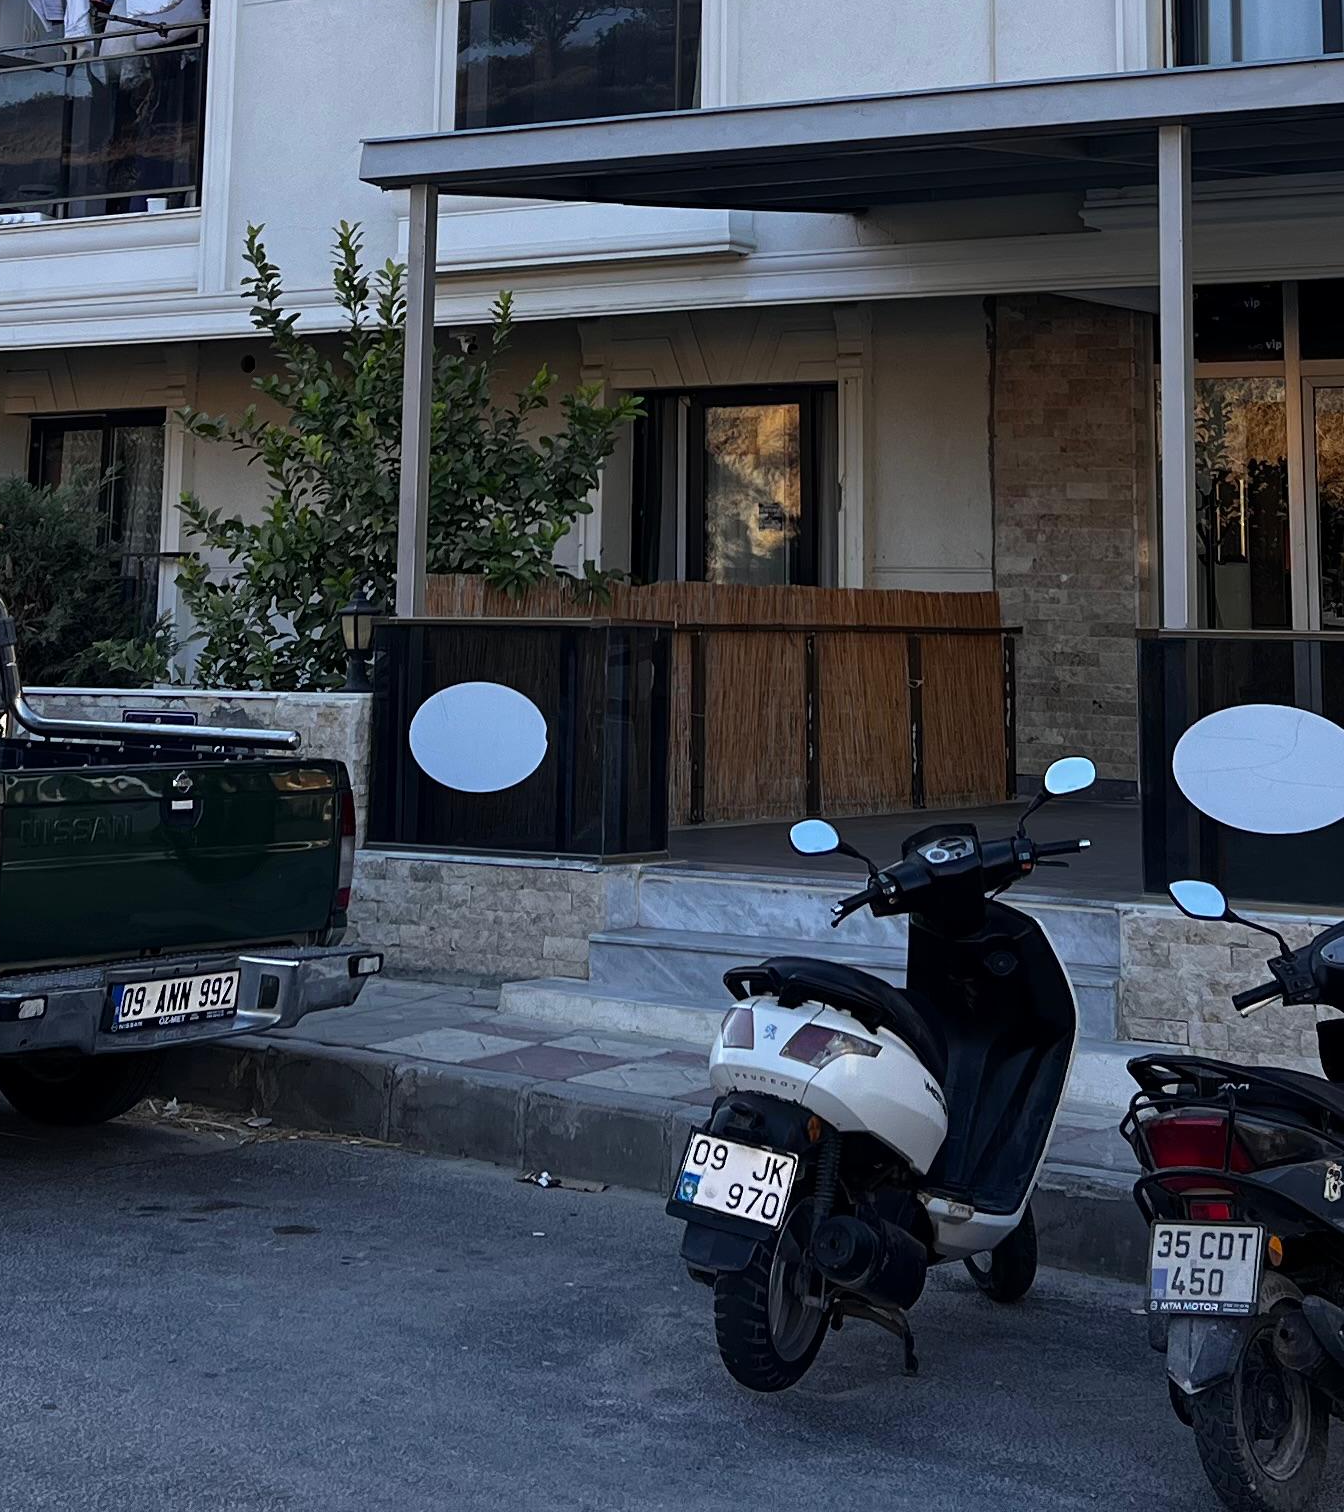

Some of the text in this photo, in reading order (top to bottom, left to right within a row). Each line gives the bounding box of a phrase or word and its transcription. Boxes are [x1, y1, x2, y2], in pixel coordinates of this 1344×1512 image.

[1266, 339, 1282, 350] vip
[20, 815, 134, 846] NISSAN
[121, 975, 234, 1018] 09 ANN 992
[734, 1073, 798, 1090] PEUGEOT
[692, 1139, 788, 1188] 09 JK
[725, 1183, 780, 1220] 970
[1157, 1230, 1253, 1261] 35 CDT
[1171, 1266, 1224, 1296] 450
[1160, 1301, 1181, 1311] MTM
[1183, 1302, 1218, 1311] MOTOR
